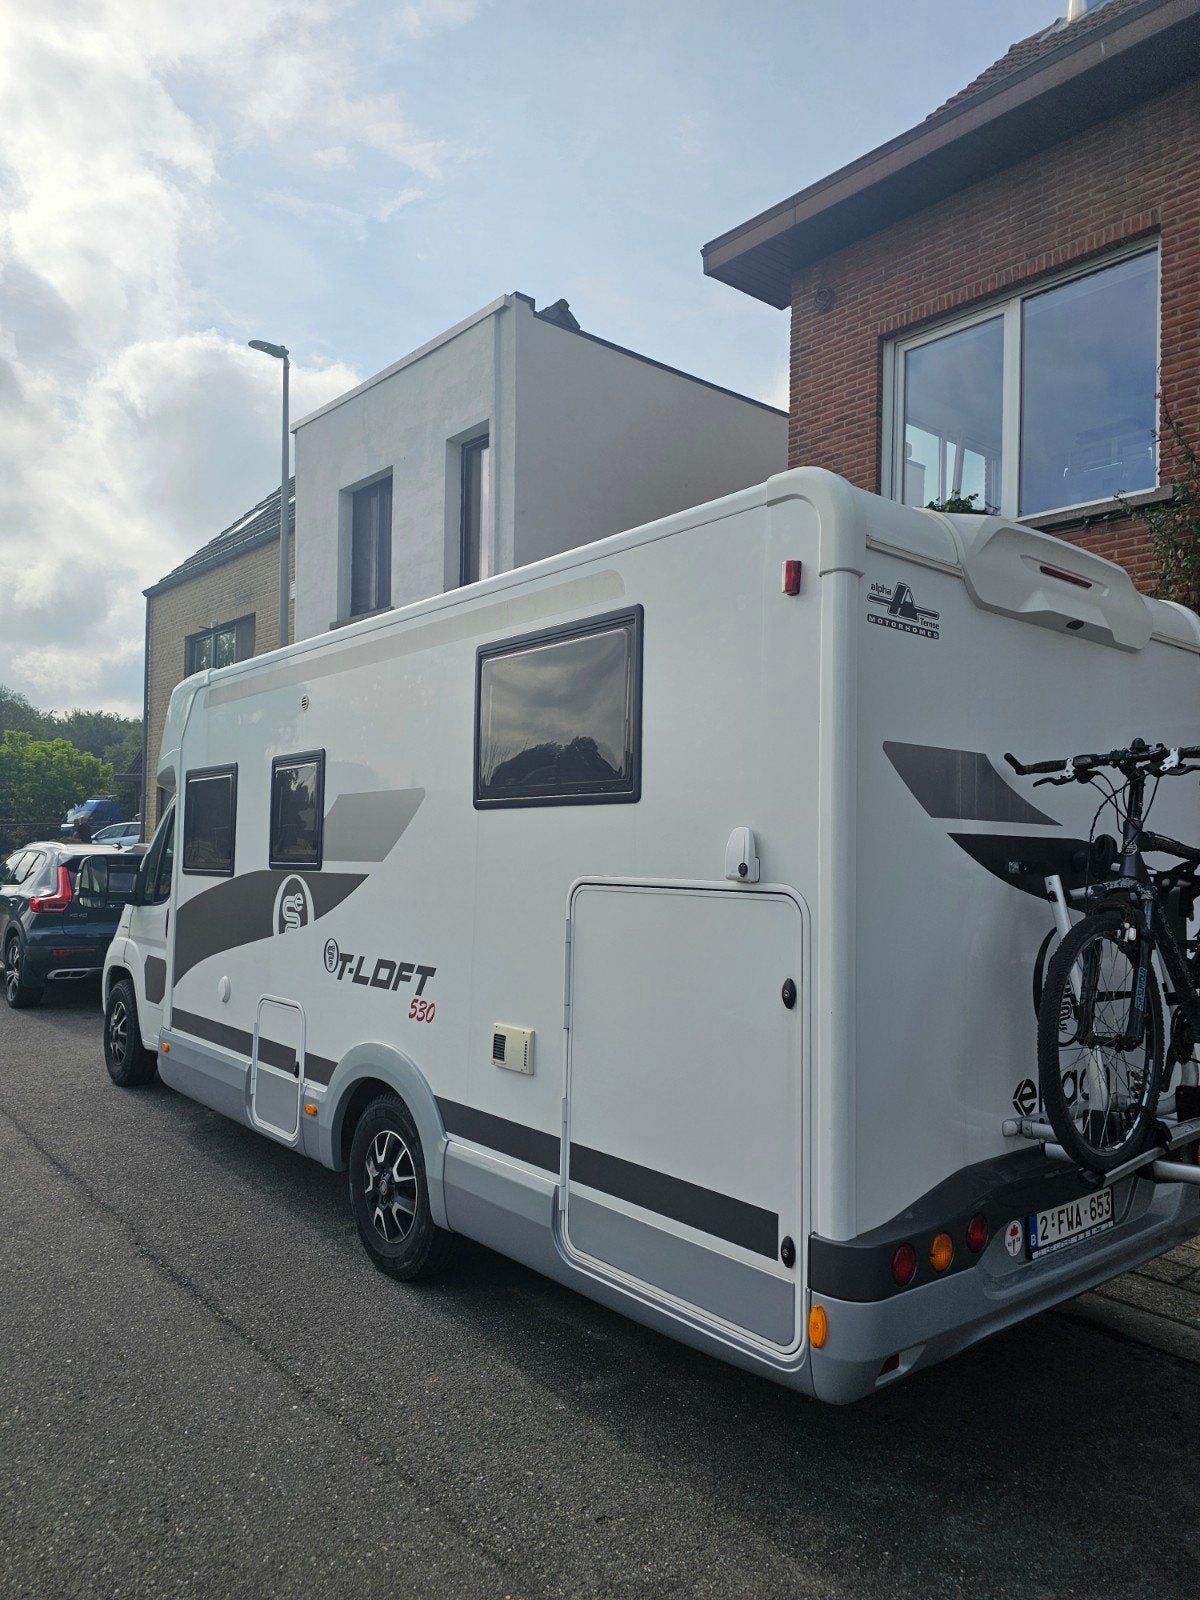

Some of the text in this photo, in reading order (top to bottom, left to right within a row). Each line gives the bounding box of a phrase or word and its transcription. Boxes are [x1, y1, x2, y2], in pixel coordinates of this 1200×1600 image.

[870, 582, 892, 596] alpha
[868, 615, 939, 639] MOTORHOMES
[920, 617, 940, 630] Temse
[337, 952, 437, 996] T-LOFT
[408, 998, 436, 1024] 530
[1030, 1234, 1037, 1246] B
